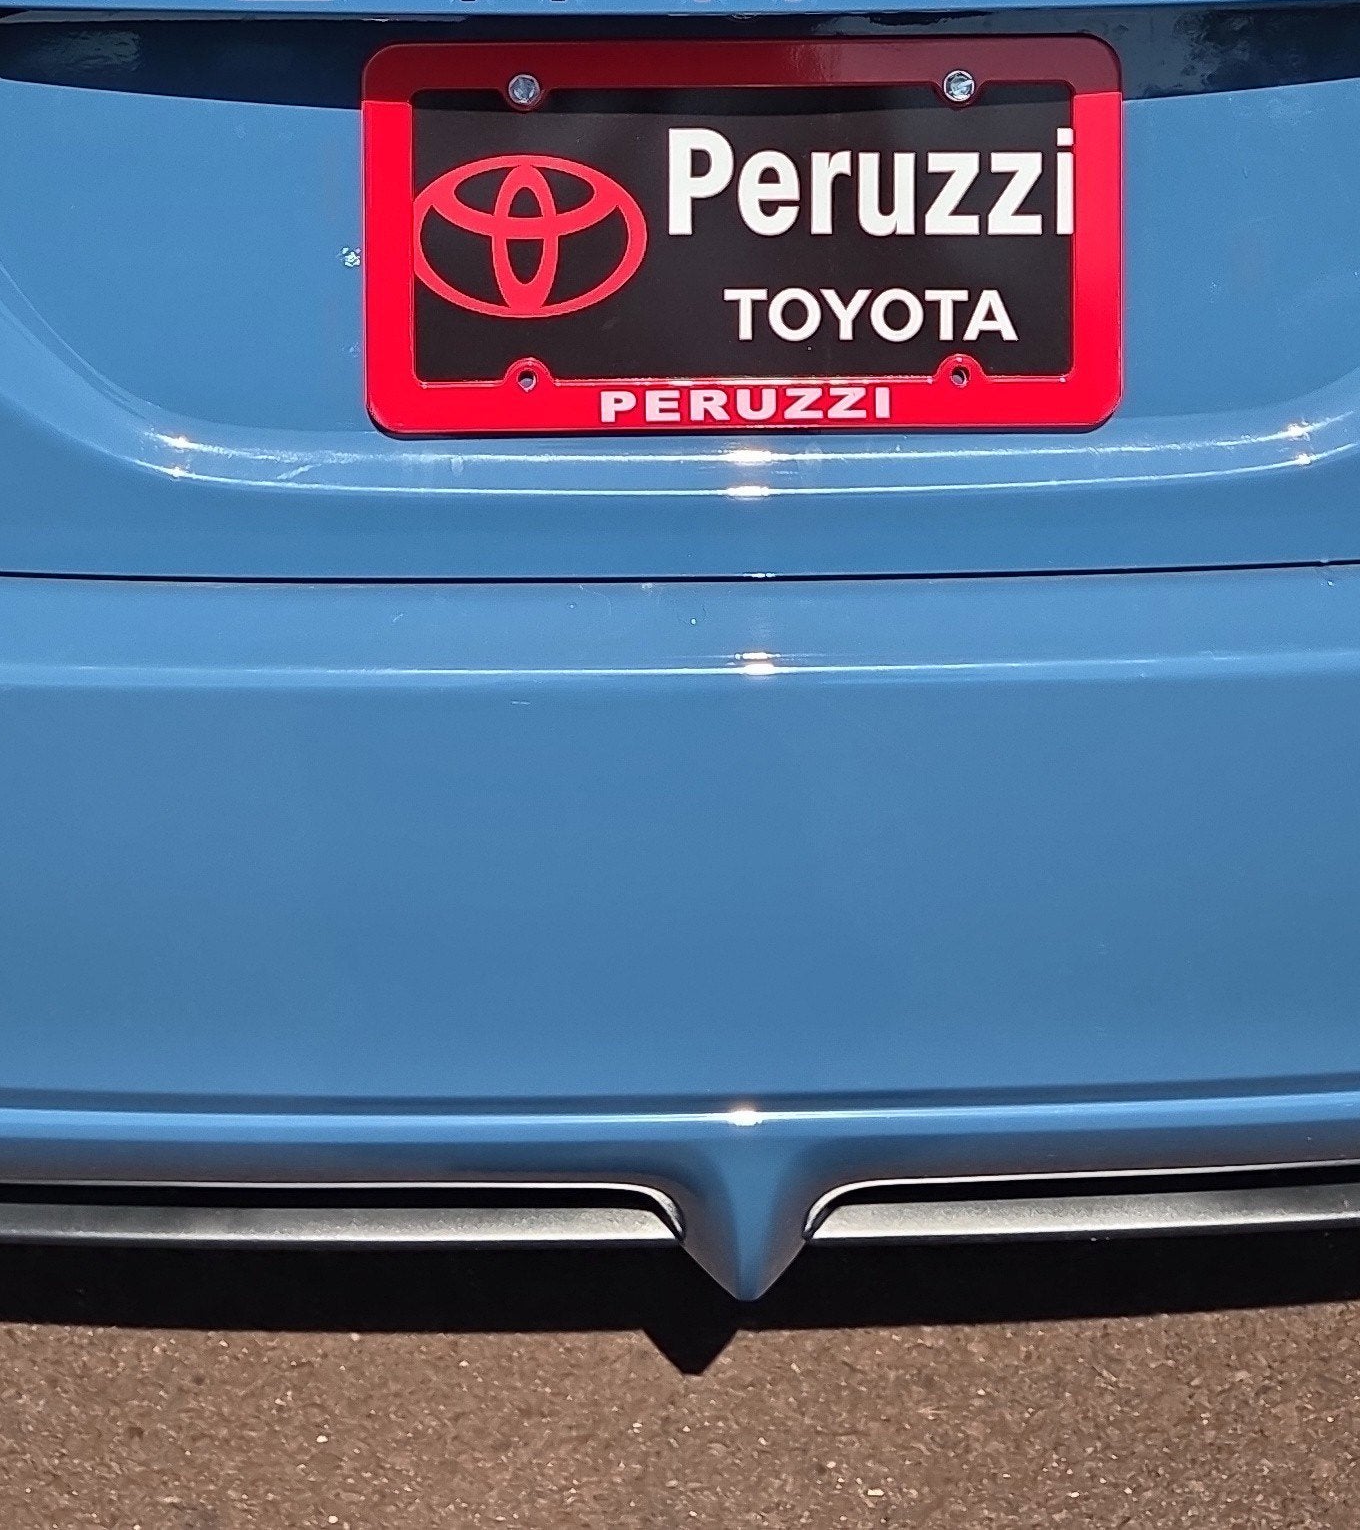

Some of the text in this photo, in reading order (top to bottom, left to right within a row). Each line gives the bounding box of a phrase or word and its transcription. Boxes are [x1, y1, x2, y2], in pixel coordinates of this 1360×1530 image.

[667, 127, 1074, 237] Peruzzi
[723, 288, 1019, 342] TOYOTA
[599, 386, 891, 423] PERUZZI
